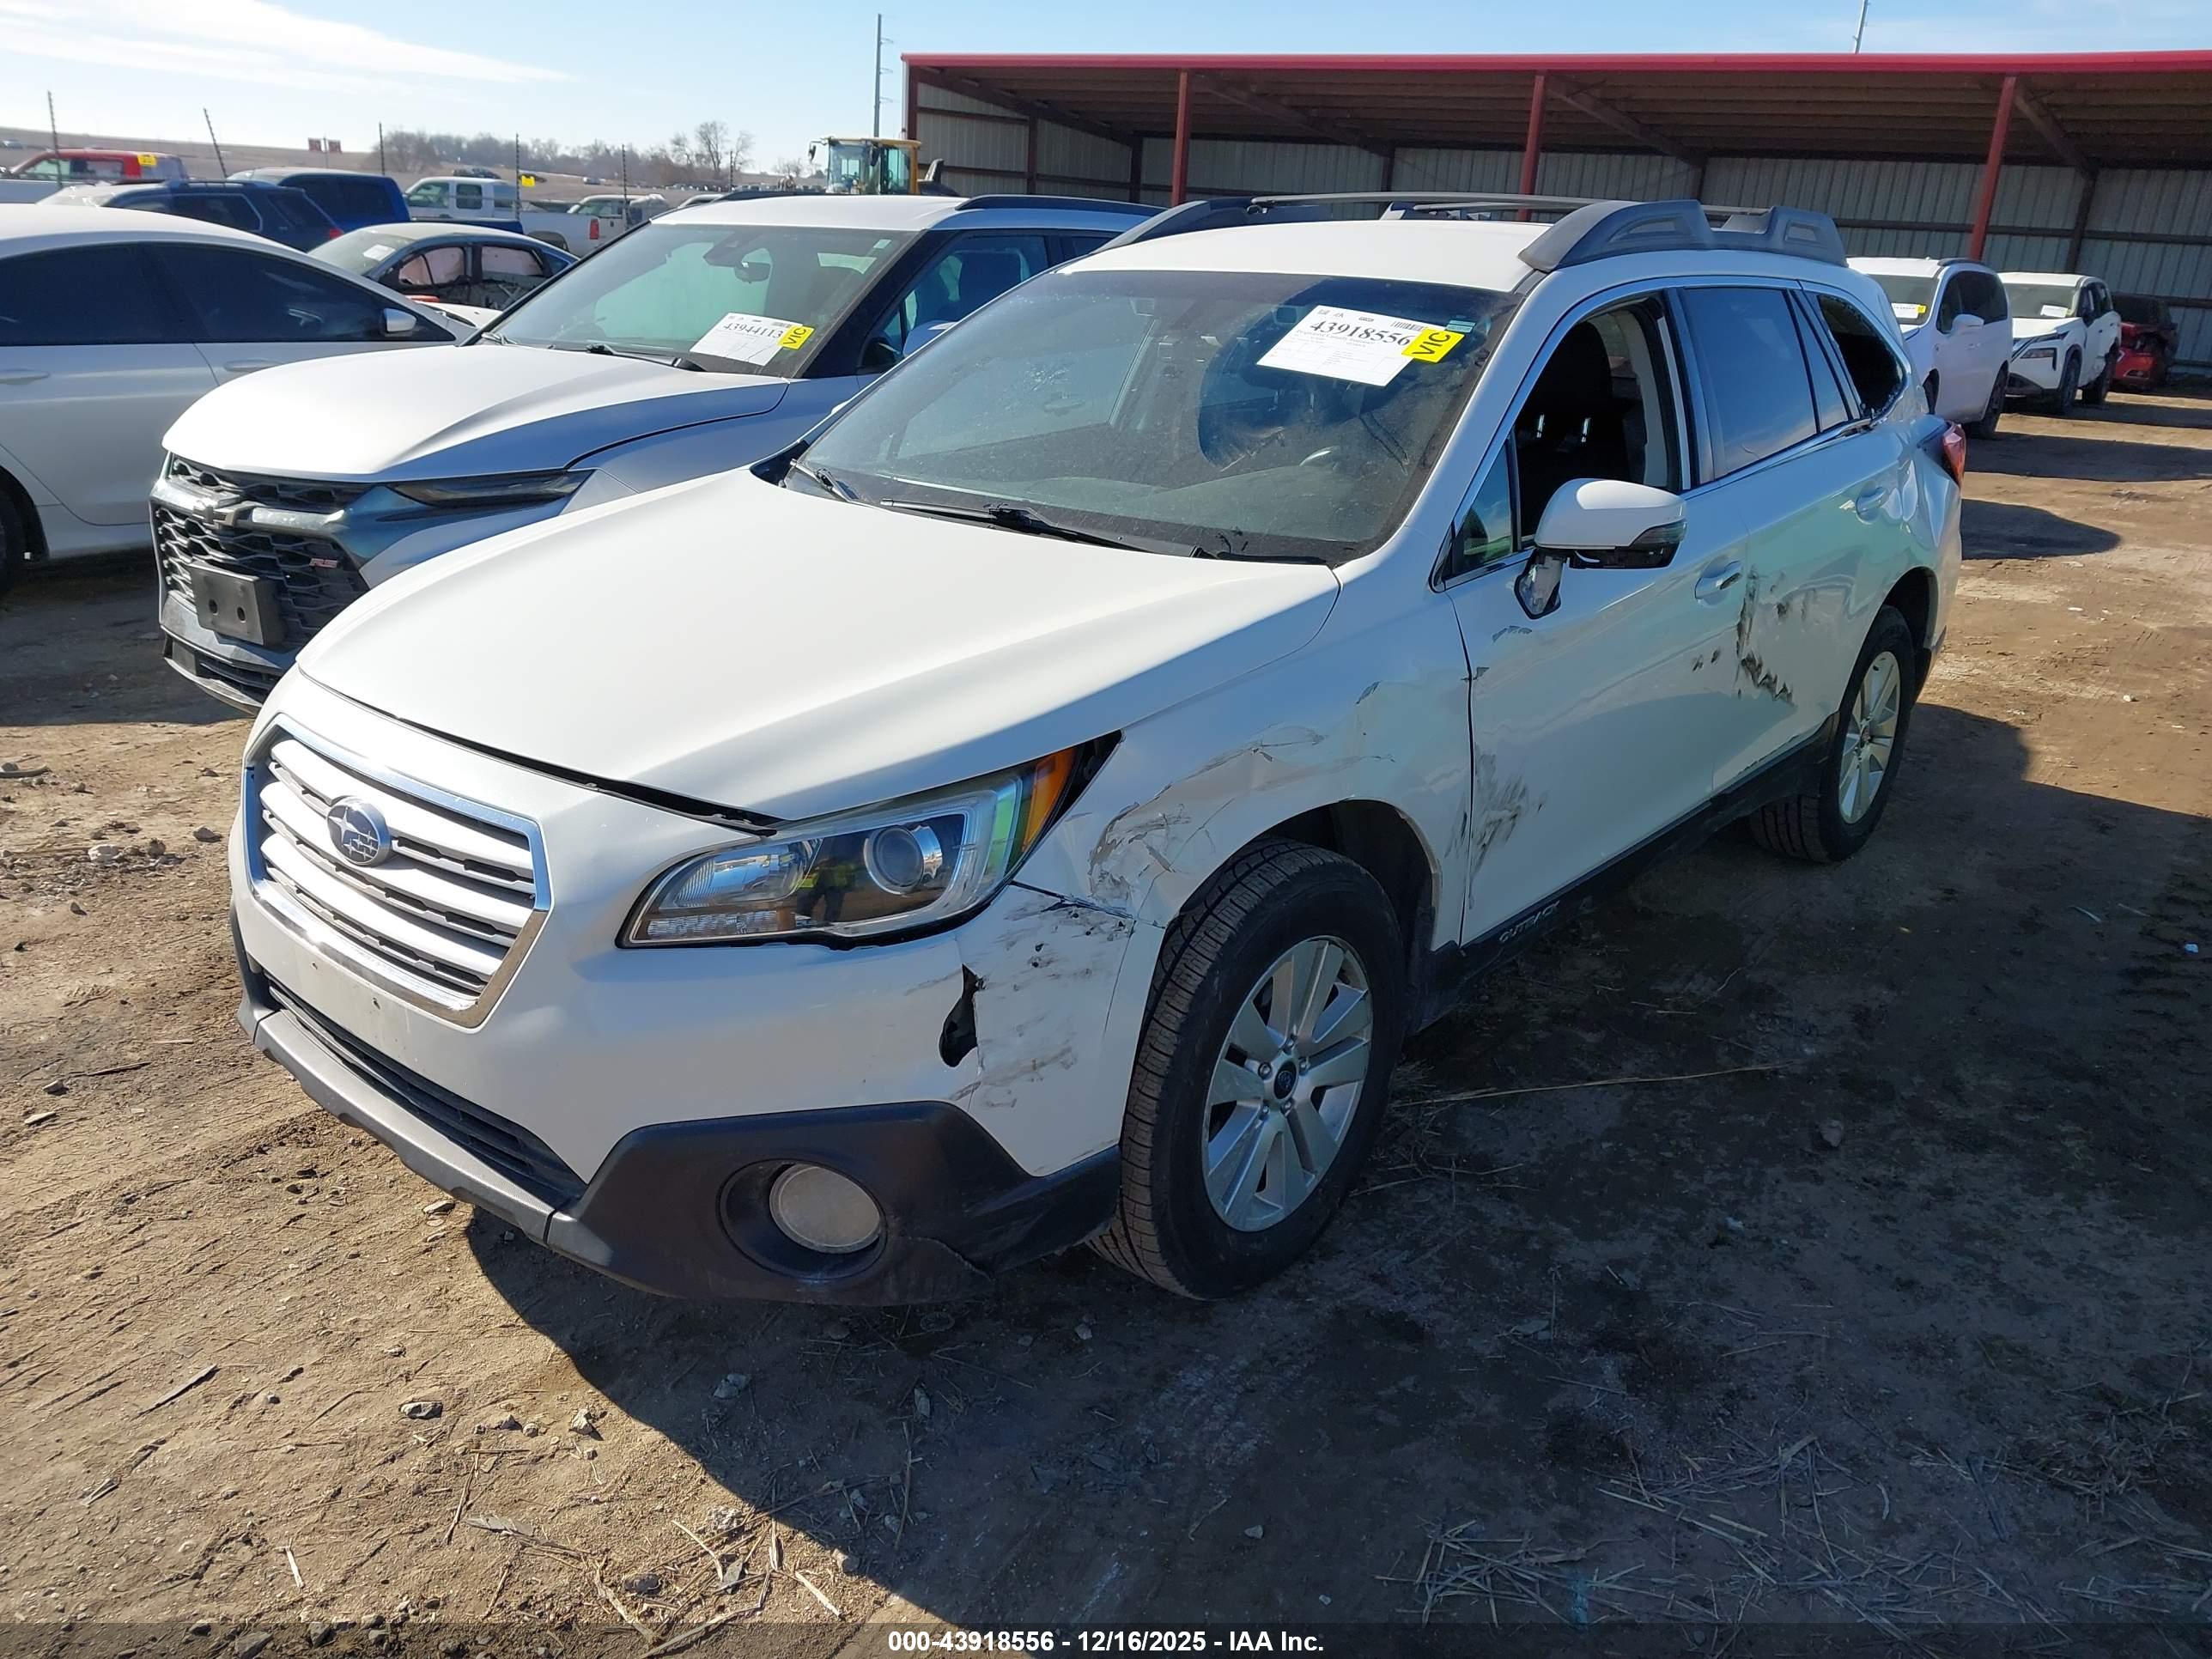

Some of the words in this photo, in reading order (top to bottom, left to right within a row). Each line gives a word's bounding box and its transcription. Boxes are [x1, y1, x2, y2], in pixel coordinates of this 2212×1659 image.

[724, 322, 784, 338] 43944113
[783, 327, 807, 345] VIC
[1310, 319, 1413, 346] 43918556
[1412, 331, 1451, 356] VIC
